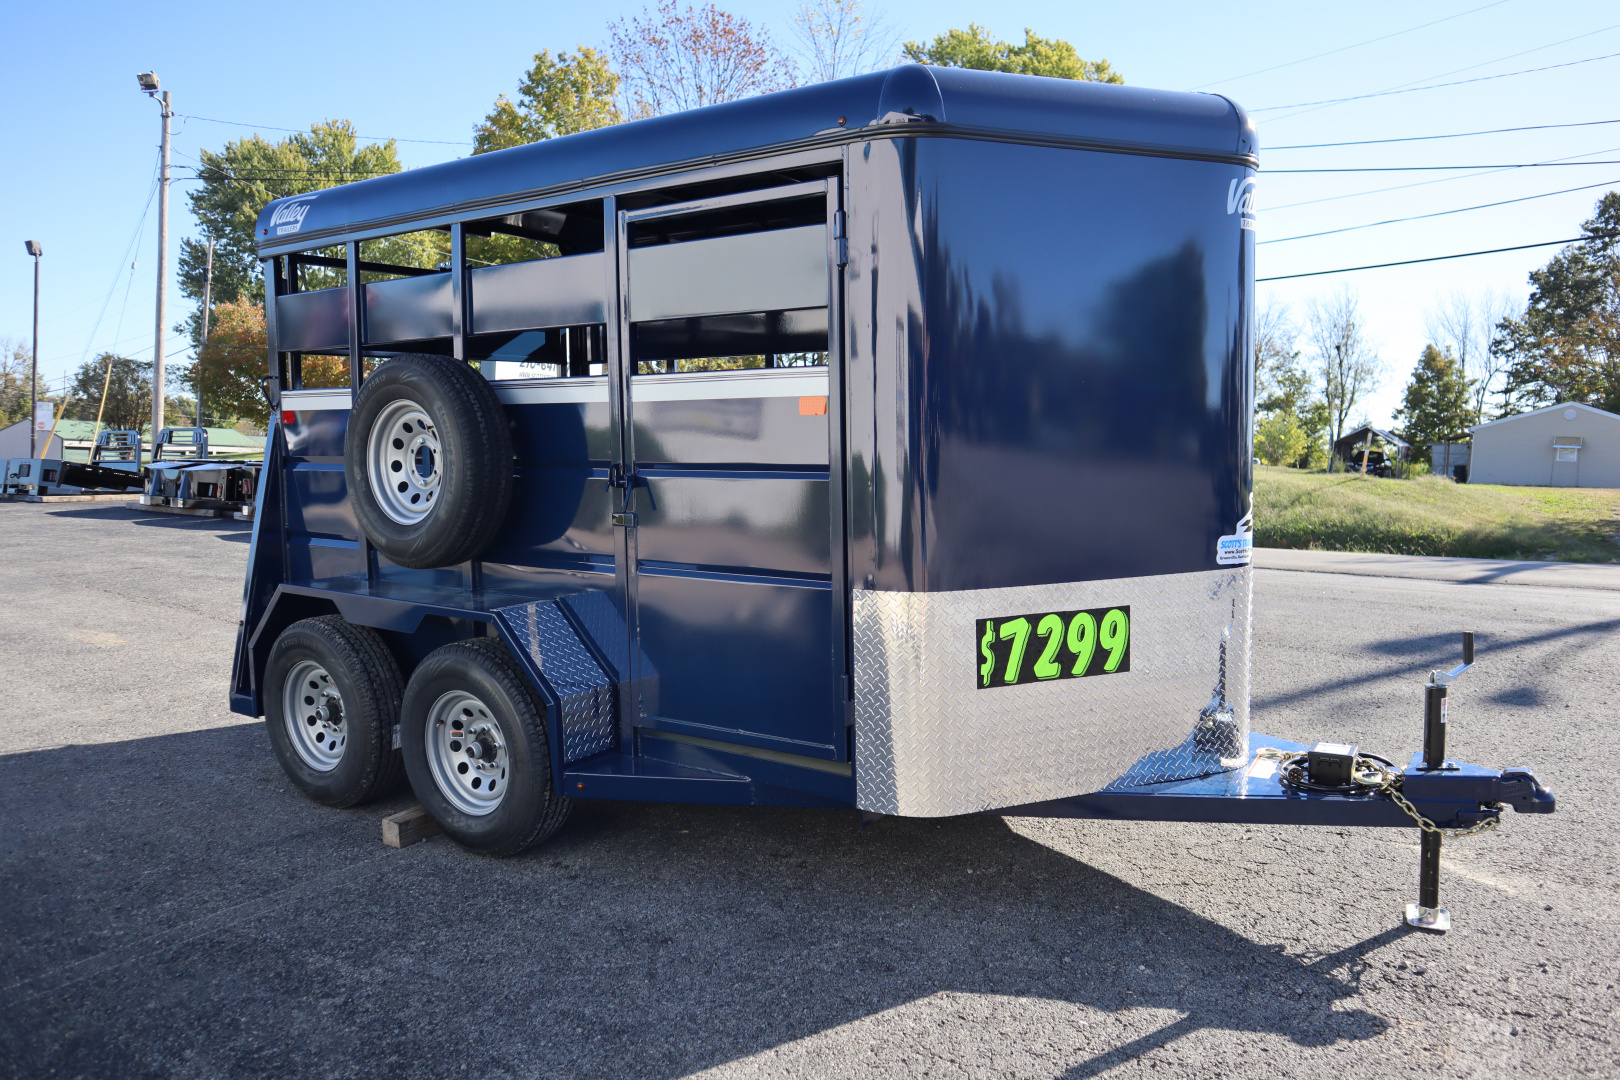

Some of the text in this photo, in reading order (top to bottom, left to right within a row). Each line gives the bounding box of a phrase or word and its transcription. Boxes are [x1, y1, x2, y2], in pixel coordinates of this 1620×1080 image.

[270, 196, 317, 227] Valley
[278, 225, 298, 234] TRAILERS
[1221, 538, 1242, 549] SCOTT'S
[980, 608, 1129, 687] $7299
